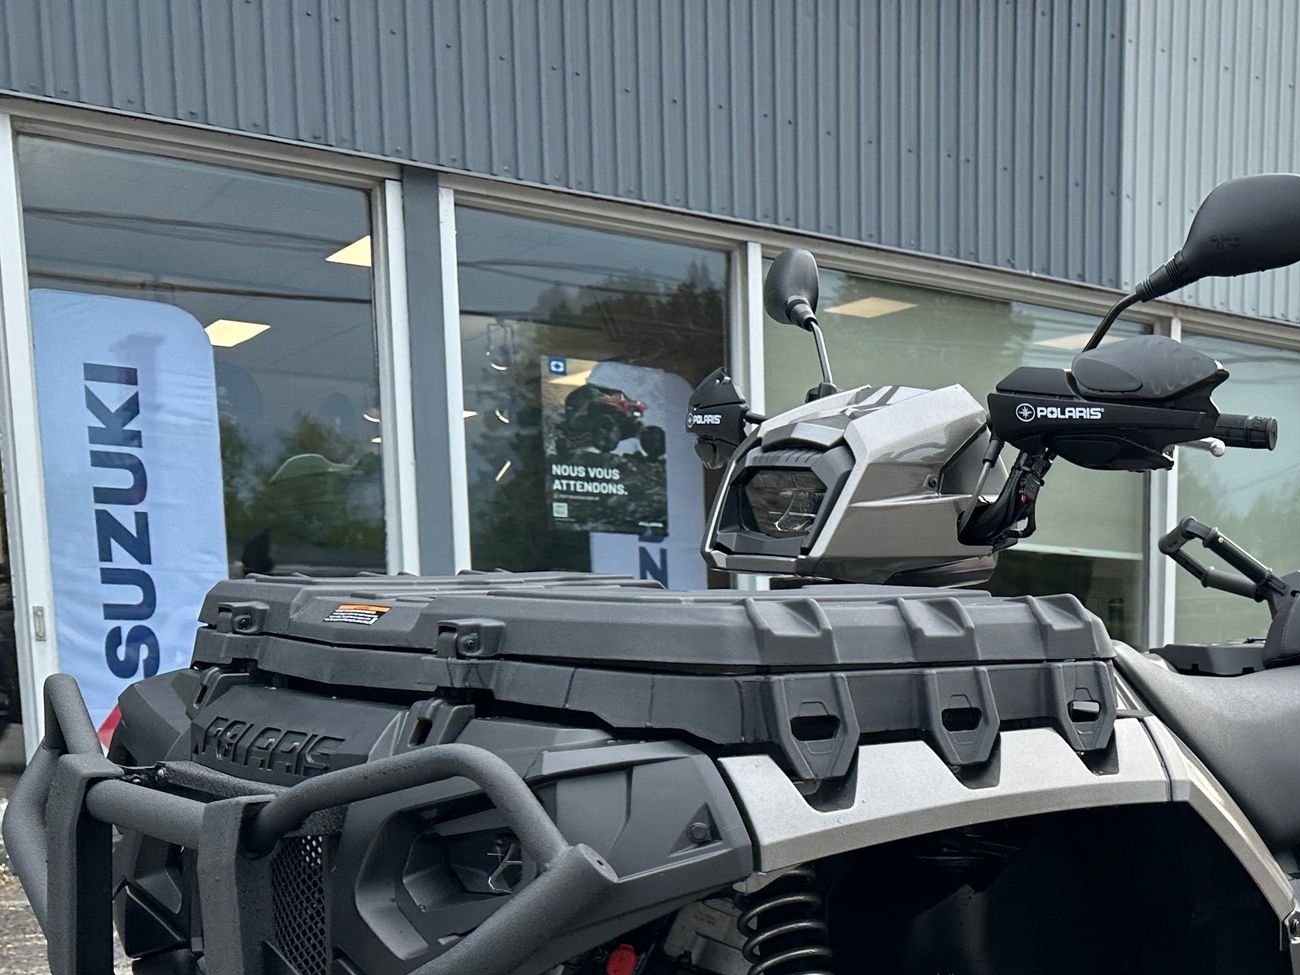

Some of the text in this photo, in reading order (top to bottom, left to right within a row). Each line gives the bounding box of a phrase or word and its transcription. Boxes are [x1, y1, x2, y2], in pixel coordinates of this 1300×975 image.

[692, 414, 722, 425] POLARIS
[1036, 406, 1102, 420] POLARIS
[551, 464, 620, 480] NOUS VOUS
[552, 479, 629, 496] ATTENDONS.
[83, 362, 161, 679] SUZUKI
[199, 715, 346, 778] POLARIS
